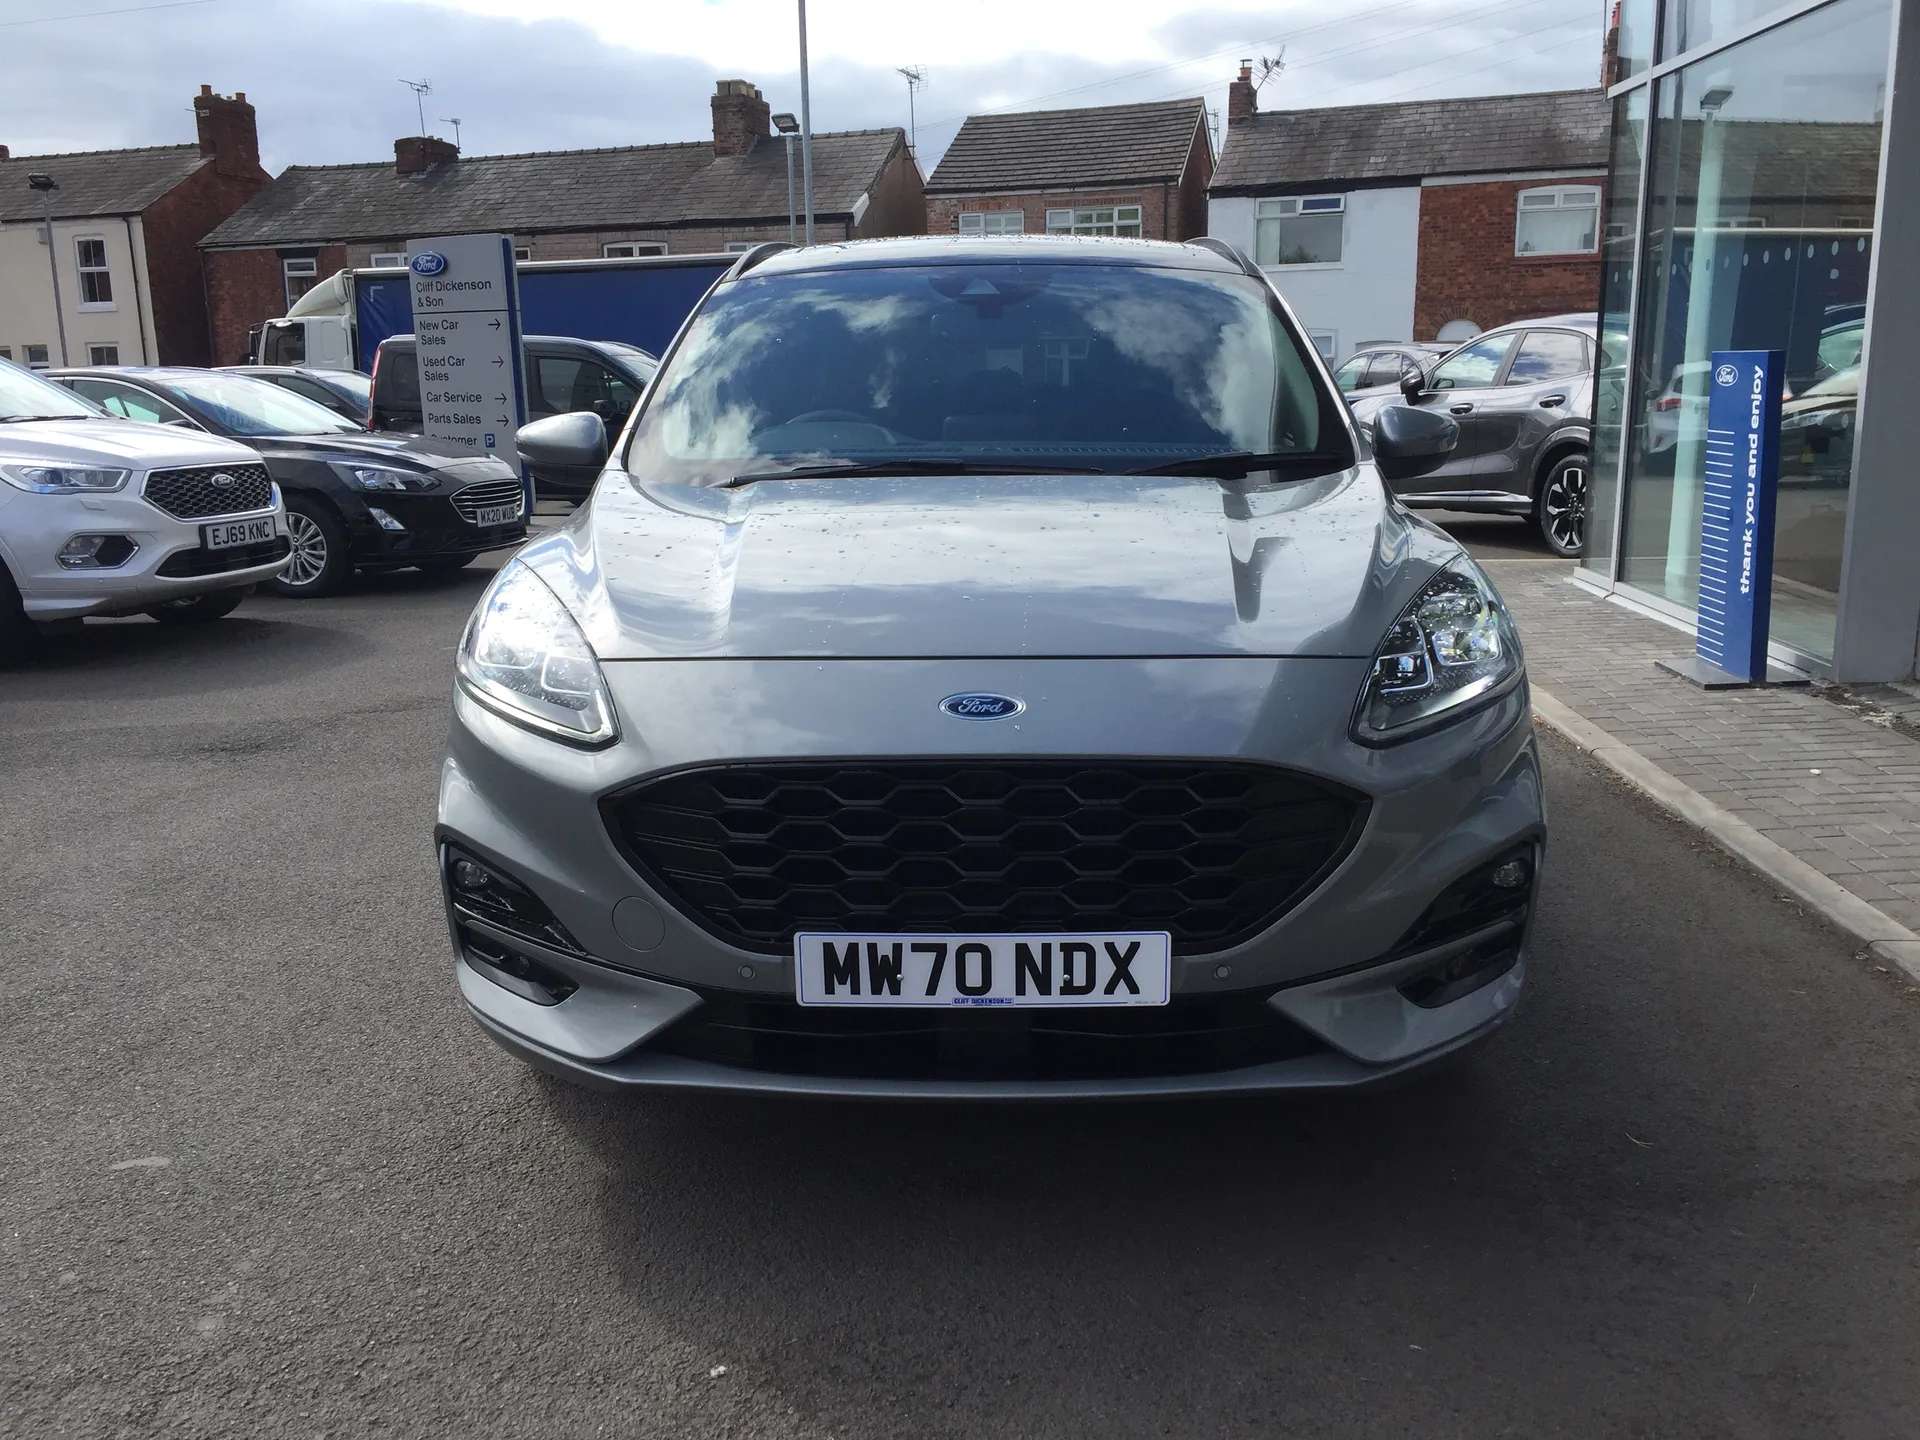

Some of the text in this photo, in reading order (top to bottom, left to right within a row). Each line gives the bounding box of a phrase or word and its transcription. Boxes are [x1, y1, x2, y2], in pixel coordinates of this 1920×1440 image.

[416, 280, 492, 293] Cliff Dickenson
[417, 296, 444, 307] & Son
[419, 319, 459, 331] New Car
[421, 334, 446, 345] Sales
[423, 355, 465, 367] Used Car
[424, 370, 449, 381] Sales
[426, 391, 482, 403] Car Service
[428, 412, 482, 424] Parts Sales
[1740, 365, 1764, 594] thank you and enjoy
[212, 522, 271, 545] EJ69 KNC
[958, 697, 1005, 713] Ford
[822, 941, 1142, 997] MW70 NDX
